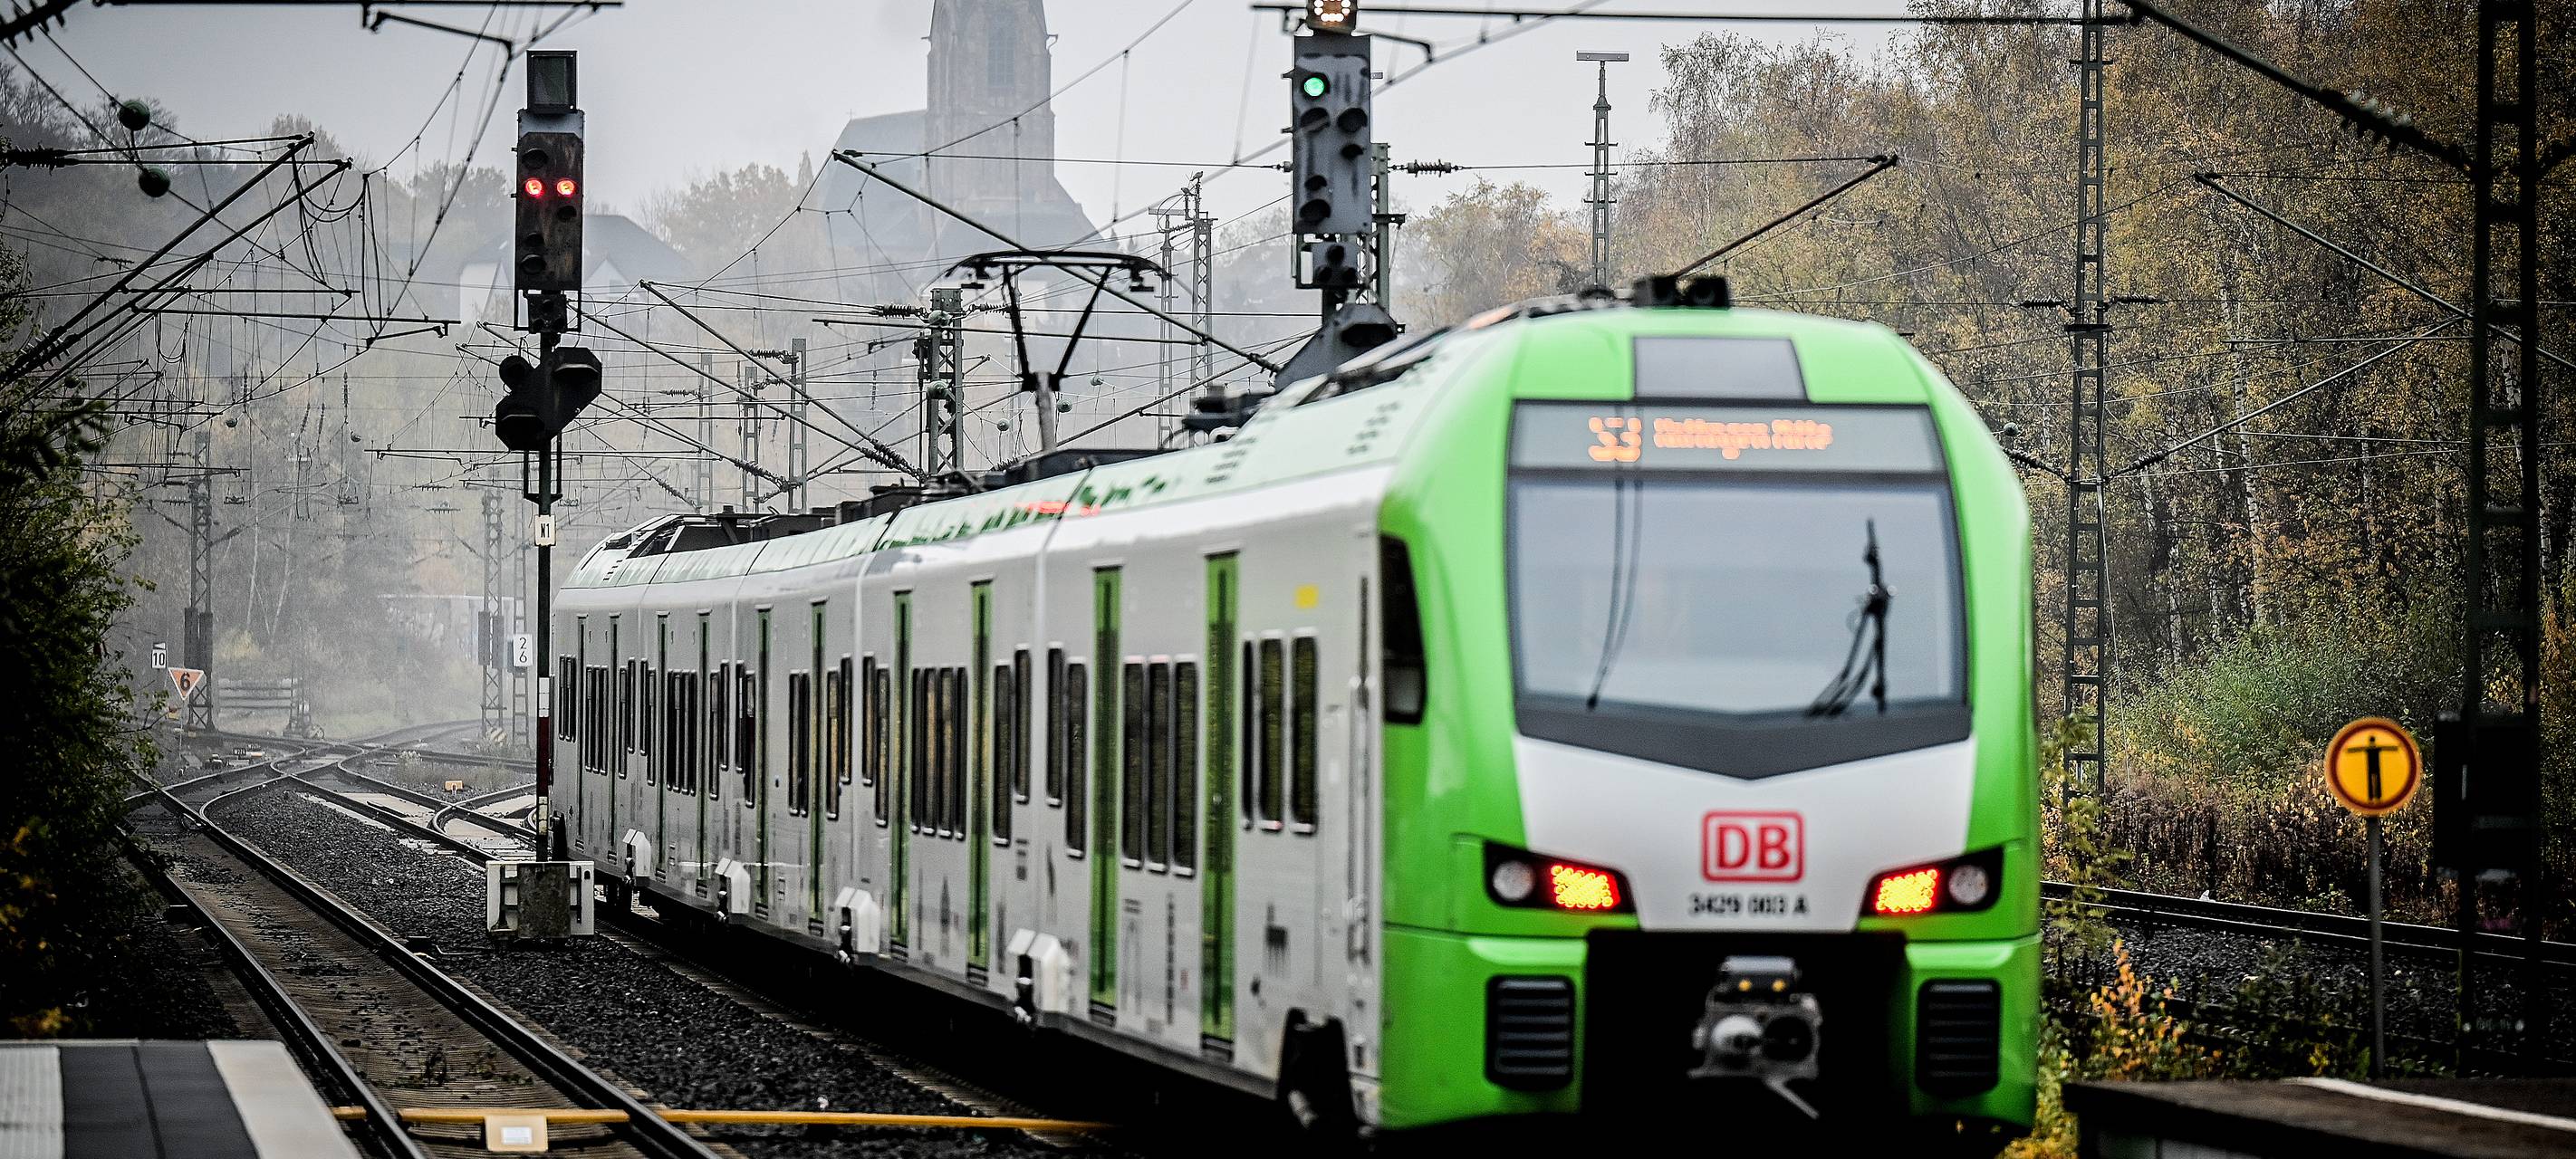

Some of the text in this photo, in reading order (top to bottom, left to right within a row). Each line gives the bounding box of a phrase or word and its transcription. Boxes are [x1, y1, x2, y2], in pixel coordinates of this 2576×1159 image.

[1589, 417, 1641, 461] S3
[541, 522, 549, 538] N1
[519, 637, 527, 649] 2
[153, 652, 165, 666] 10
[519, 651, 527, 663] 6
[180, 672, 190, 690] 6
[1717, 825, 1789, 869] DB
[1793, 895, 1810, 915] A
